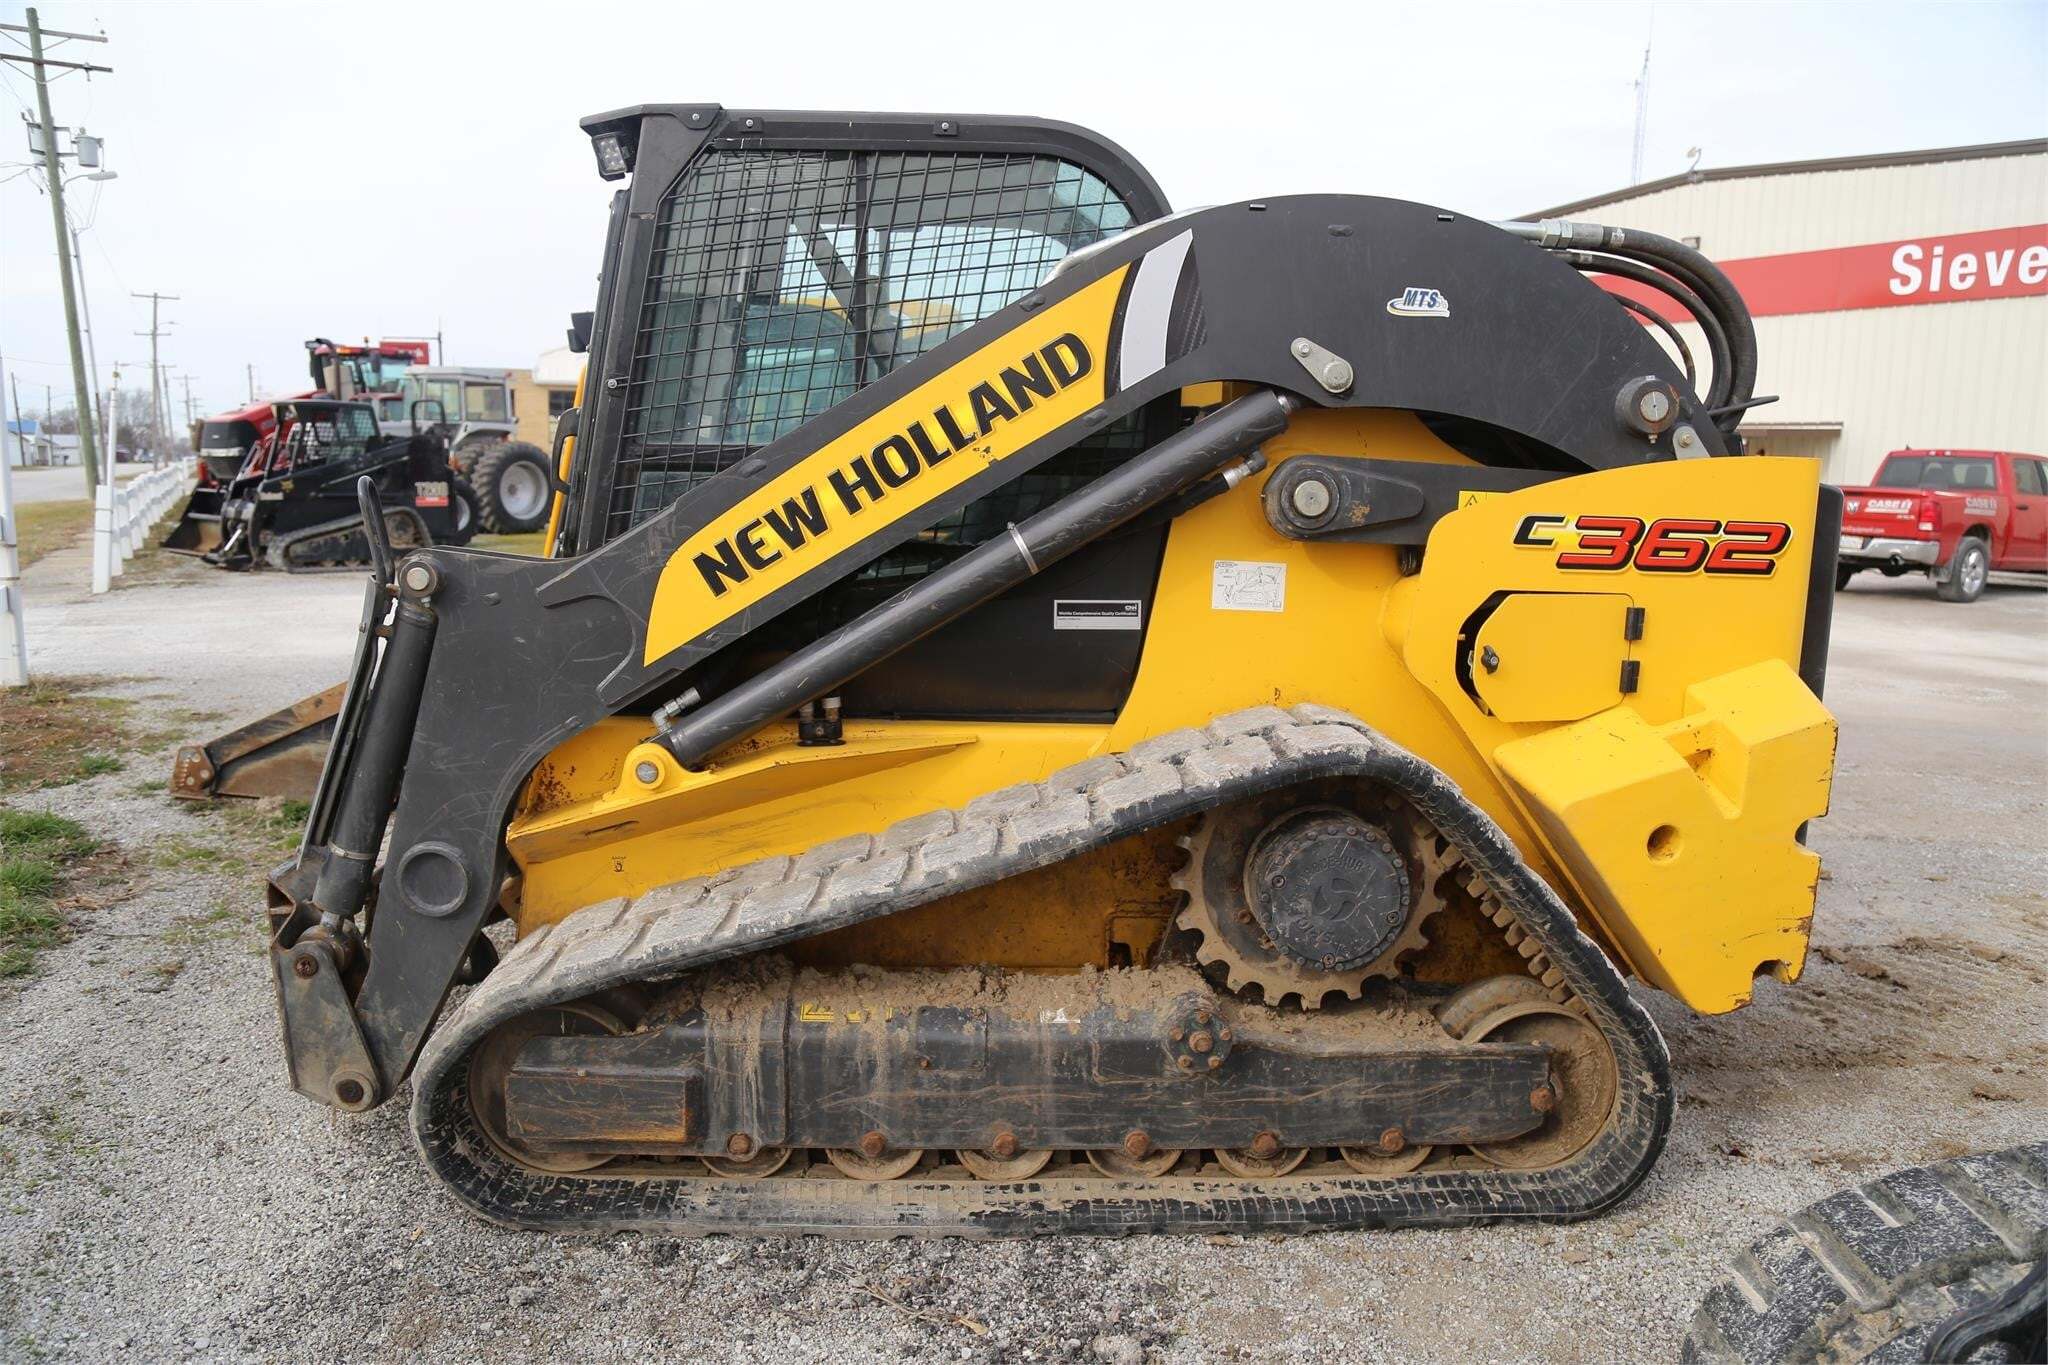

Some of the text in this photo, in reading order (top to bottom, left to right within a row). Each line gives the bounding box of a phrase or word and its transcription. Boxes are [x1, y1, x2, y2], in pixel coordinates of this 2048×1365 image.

[1889, 244, 2048, 296] Sieve
[1403, 289, 1440, 308] MTS
[692, 333, 1092, 598] NEW HOLLAND
